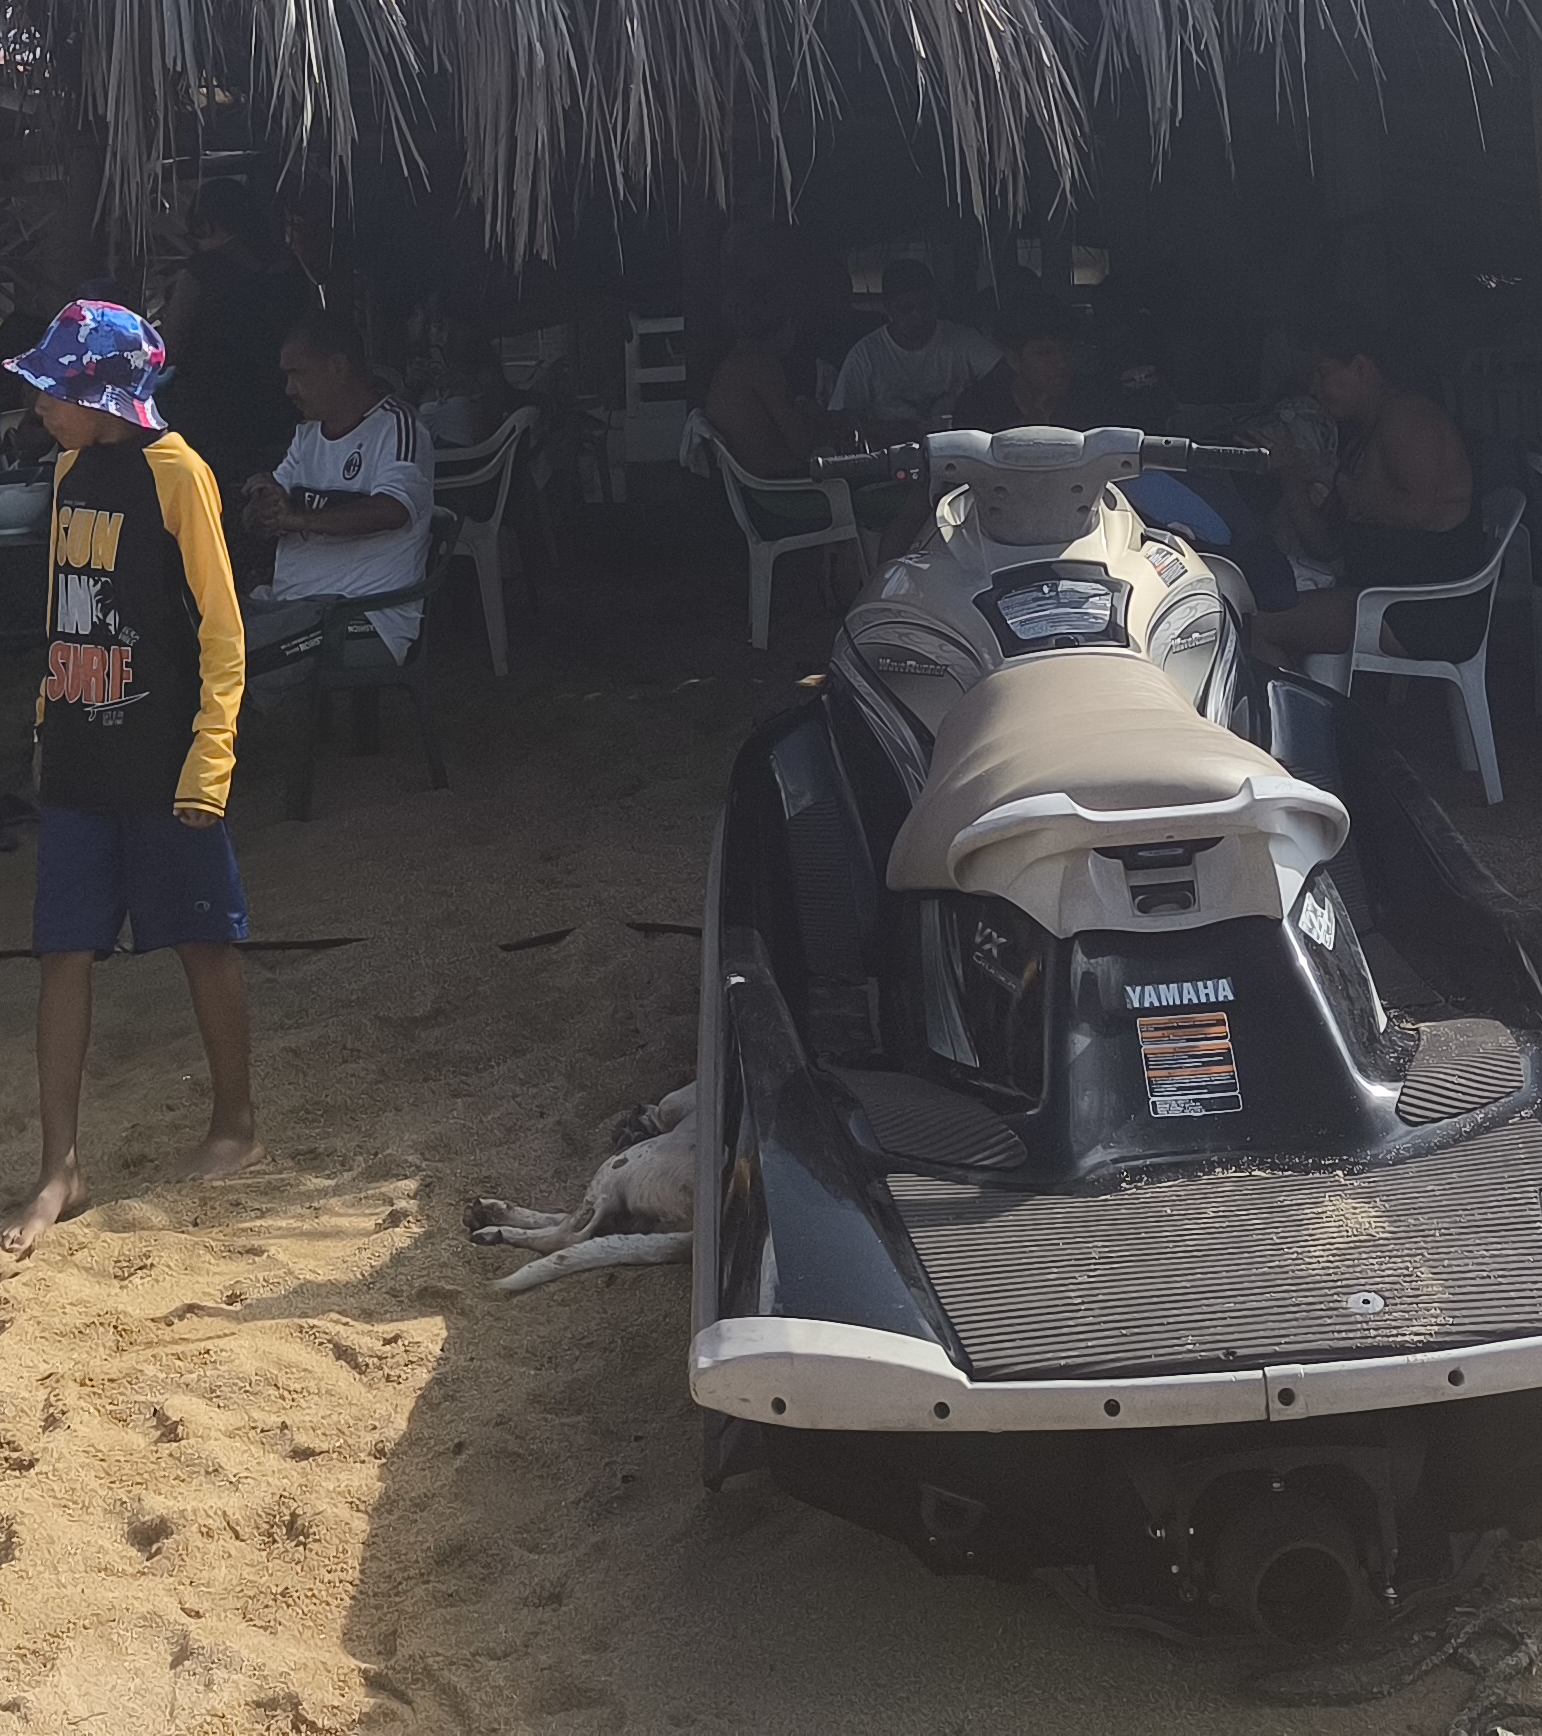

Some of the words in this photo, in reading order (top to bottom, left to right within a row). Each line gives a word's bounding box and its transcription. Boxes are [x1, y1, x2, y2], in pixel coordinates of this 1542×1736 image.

[46, 639, 133, 705] SURF
[878, 657, 947, 677] WaveRunner
[974, 921, 1008, 959] VX
[1125, 977, 1235, 1009] YAMAHA
